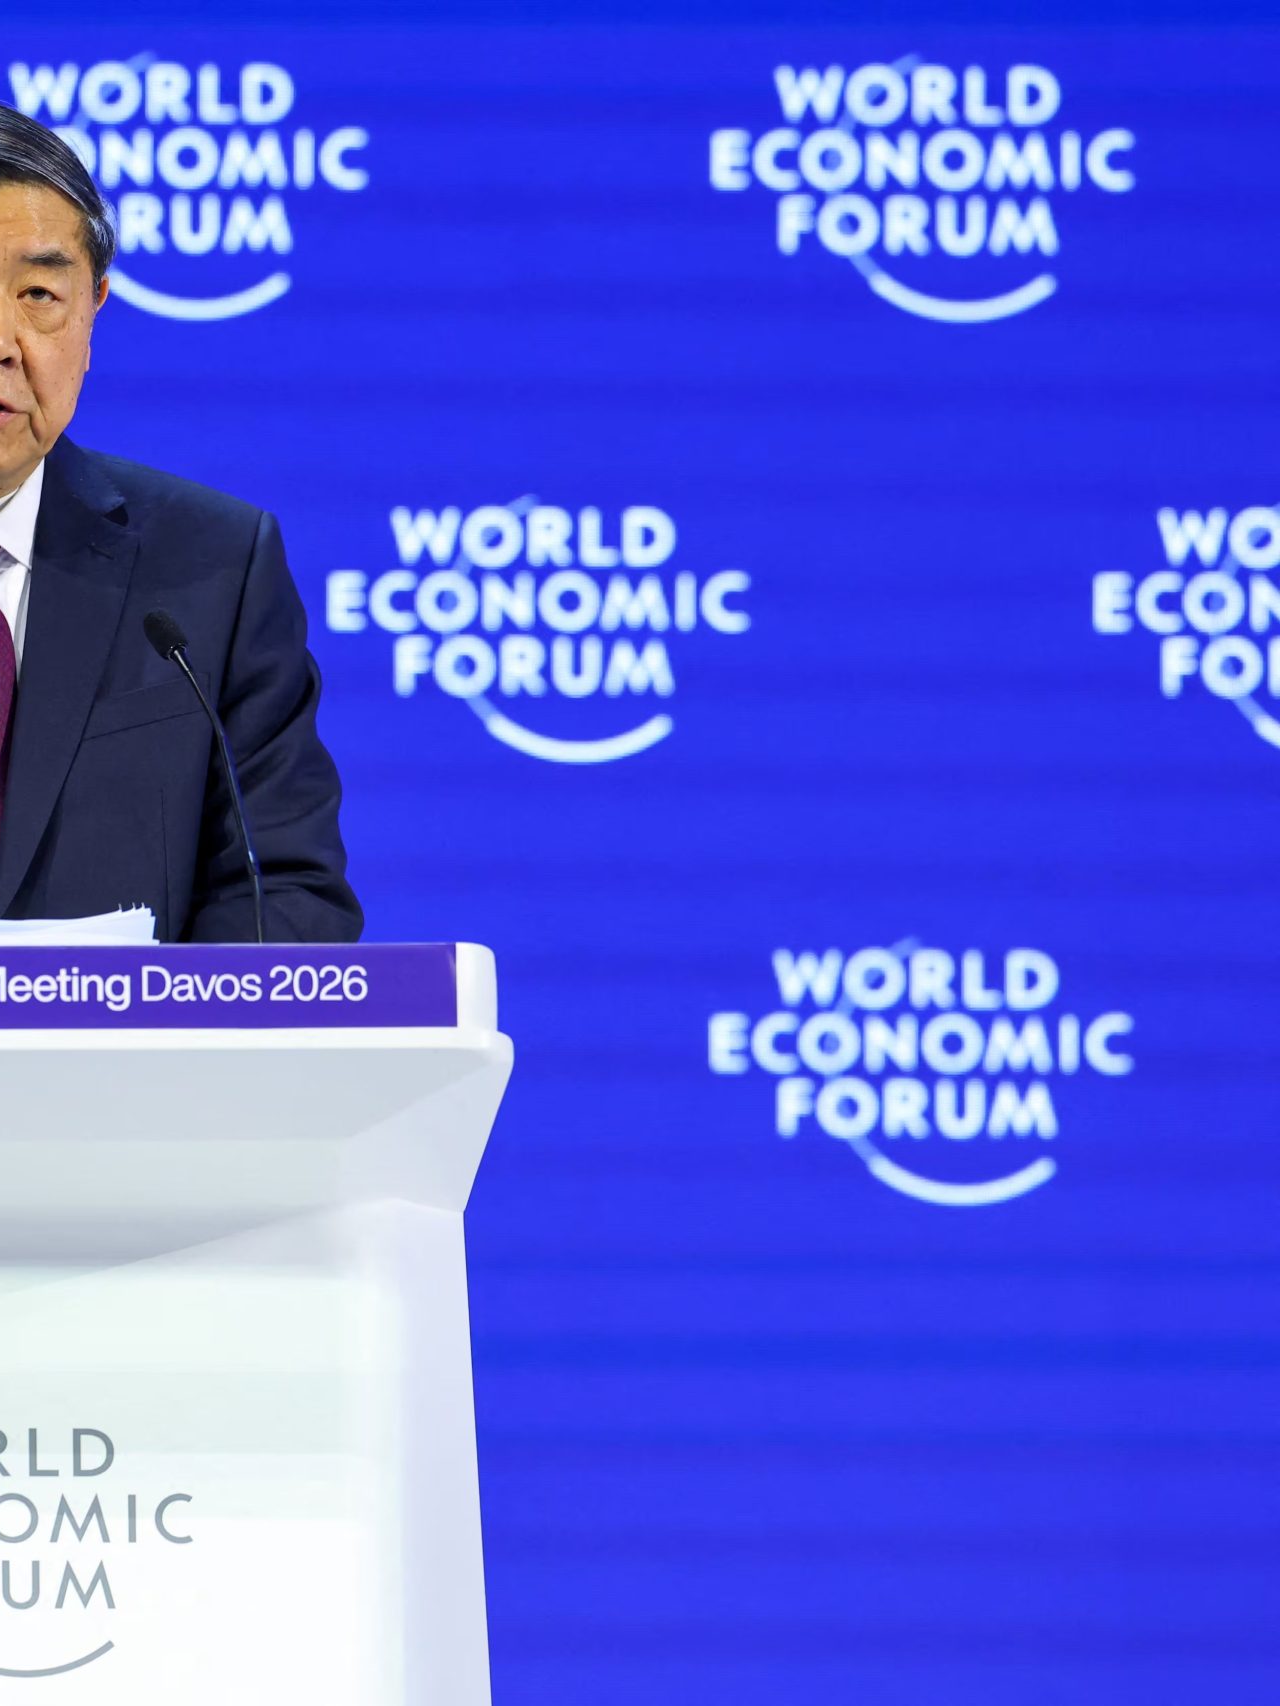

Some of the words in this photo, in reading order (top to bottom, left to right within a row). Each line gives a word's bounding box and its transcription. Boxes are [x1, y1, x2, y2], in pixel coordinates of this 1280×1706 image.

[10, 62, 294, 123] WORLD
[775, 65, 1060, 125] WORLD
[52, 127, 365, 191] NOMIC
[710, 129, 1131, 192] ECONOMIC
[118, 192, 291, 254] RUM
[778, 194, 1057, 256] FORUM
[391, 506, 675, 568] WORLD
[326, 569, 746, 634] ECONOMIC
[1092, 571, 1280, 634] ECON
[394, 634, 673, 699] FORUM
[142, 966, 262, 1001] Davos
[270, 965, 367, 1001] 2026
[774, 948, 1058, 1010] WORLD
[708, 1011, 1129, 1075] ECONOMIC
[777, 1077, 1056, 1140] FORUM
